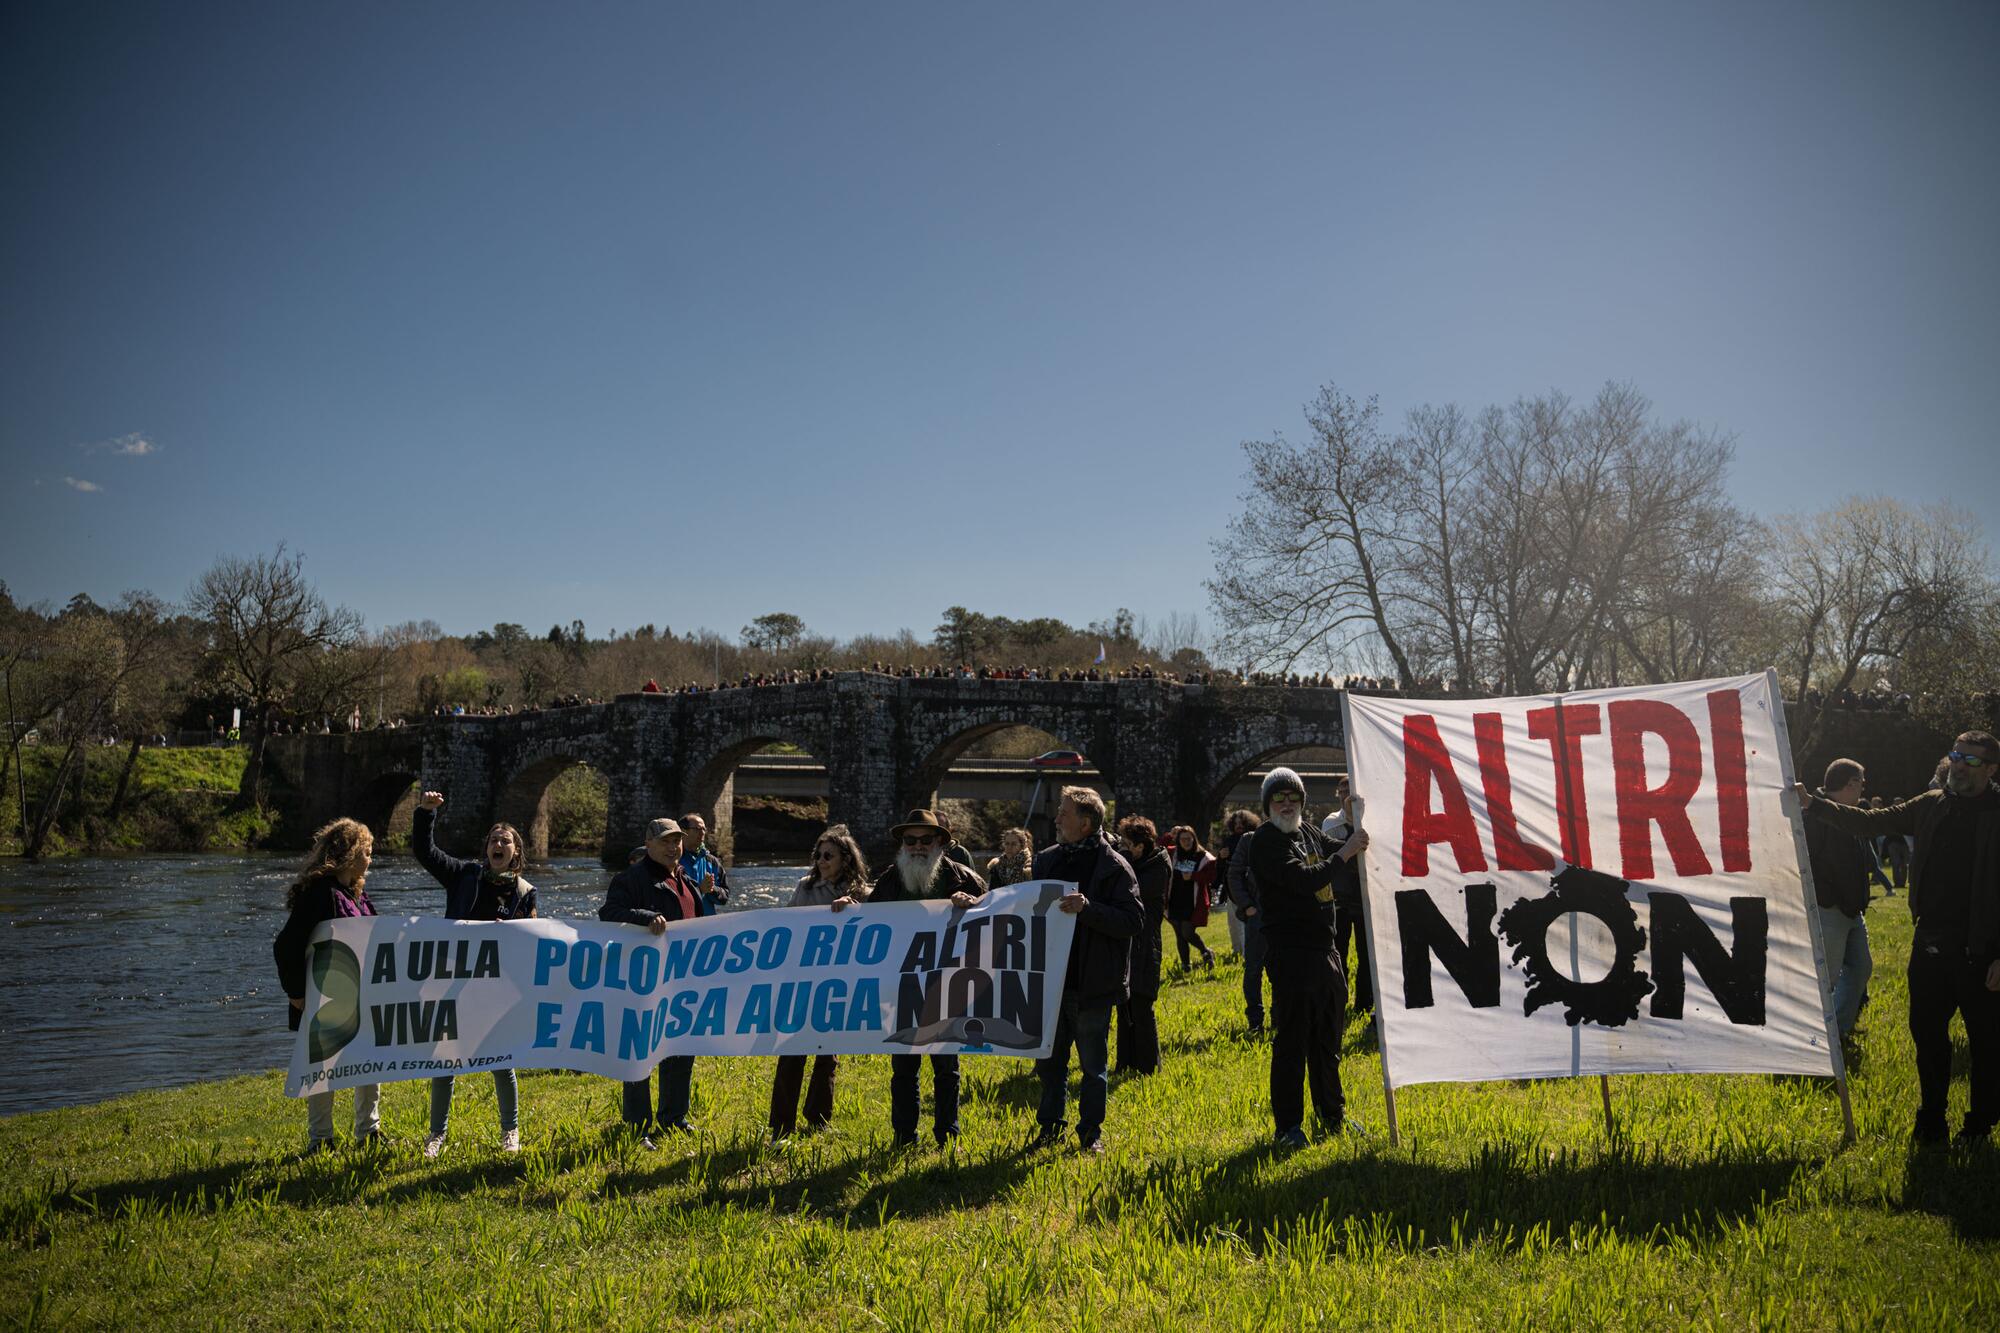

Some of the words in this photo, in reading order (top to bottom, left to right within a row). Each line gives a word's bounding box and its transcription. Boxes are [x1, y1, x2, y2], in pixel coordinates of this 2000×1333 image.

[1402, 688, 1752, 880] ALTRI
[371, 942, 397, 984] A
[407, 940, 500, 981] ULLA
[534, 938, 660, 995] POLO
[663, 926, 792, 984] NOSO
[800, 917, 892, 967] RÍO
[899, 914, 1046, 973] ALTRI
[1395, 866, 1769, 1027] NON
[370, 999, 458, 1047] VIVA
[532, 1002, 563, 1049] E
[570, 1001, 605, 1054] A
[617, 987, 728, 1061] NOSA
[736, 978, 882, 1034] AUGA
[897, 967, 1044, 1041] NON
[312, 1060, 383, 1083] BOQUEIXÓN
[386, 1061, 397, 1071] A
[401, 1059, 463, 1070] ESTRADA
[468, 1054, 512, 1068] VEDRA
